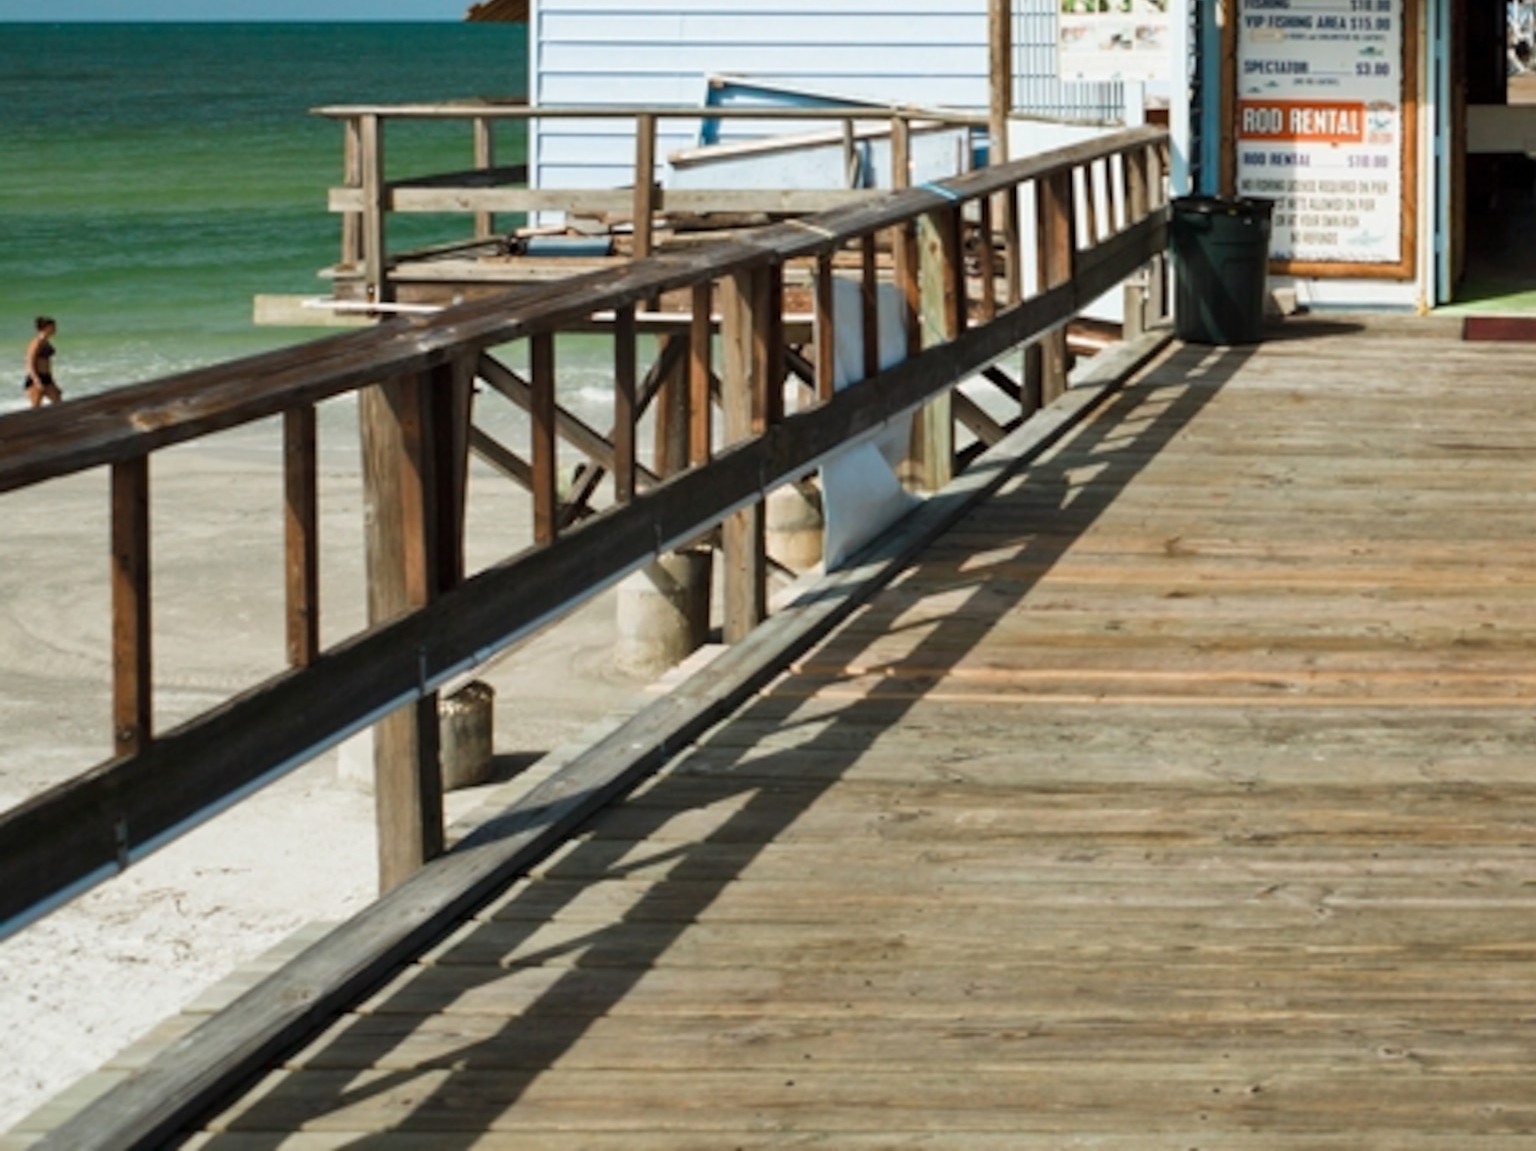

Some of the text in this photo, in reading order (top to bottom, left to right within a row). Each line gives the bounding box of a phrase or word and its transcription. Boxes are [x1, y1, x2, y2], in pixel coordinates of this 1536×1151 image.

[1245, 15, 1391, 31] VIP FISHING AREA $15.00
[1244, 60, 1390, 76] SPECTATOR $3.00
[1243, 107, 1283, 134] ROD
[1289, 109, 1360, 135] RENTAL
[1243, 152, 1266, 166] ROD
[1269, 153, 1310, 167] RENTAL
